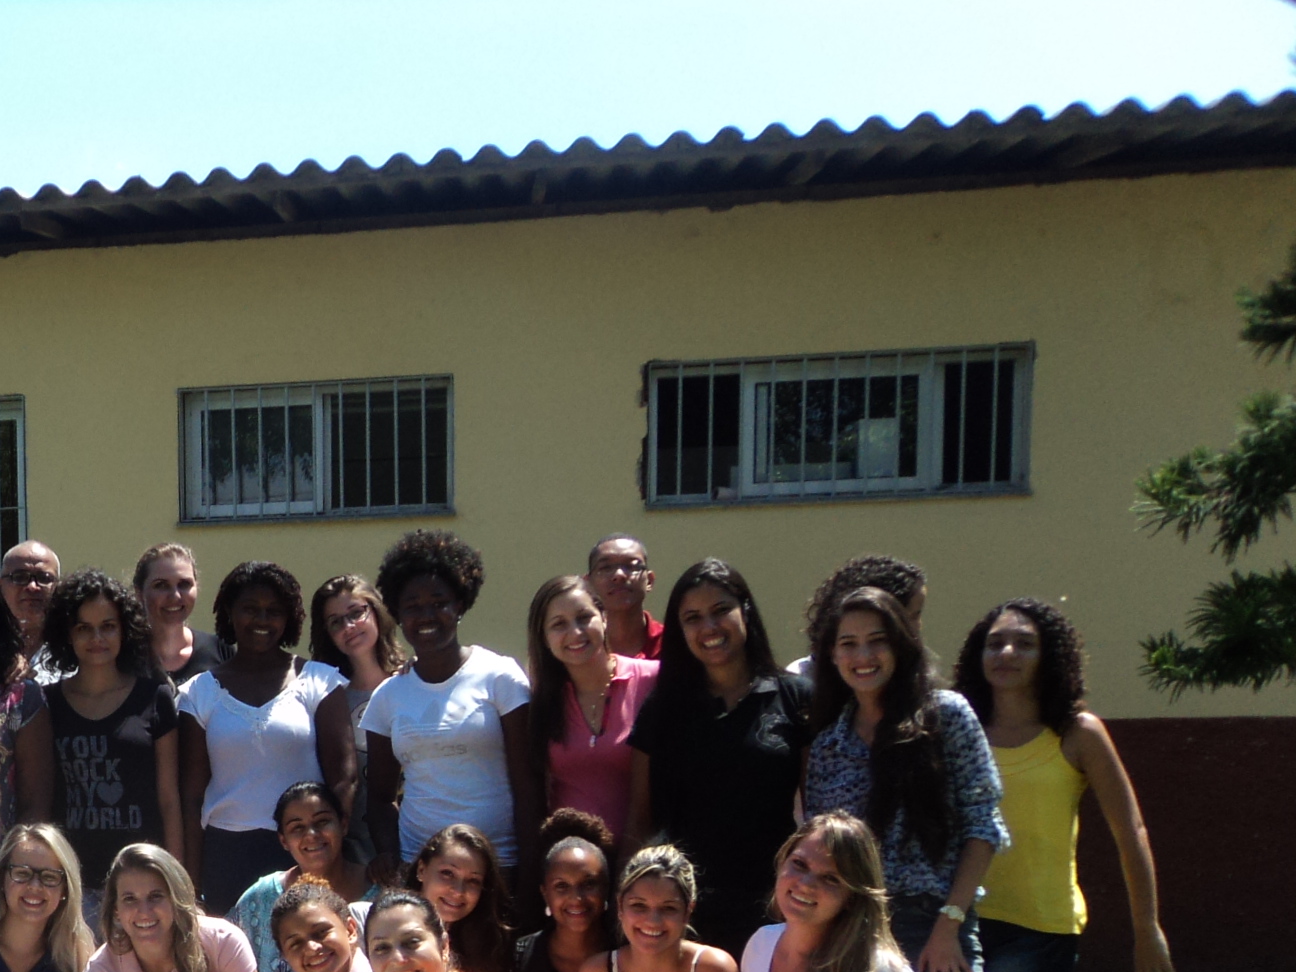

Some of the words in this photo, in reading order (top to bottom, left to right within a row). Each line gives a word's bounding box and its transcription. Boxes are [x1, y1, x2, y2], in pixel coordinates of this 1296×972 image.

[55, 735, 108, 759] YOU
[401, 743, 467, 764] addas
[66, 780, 98, 806] MY
[65, 804, 143, 830] WORLD
